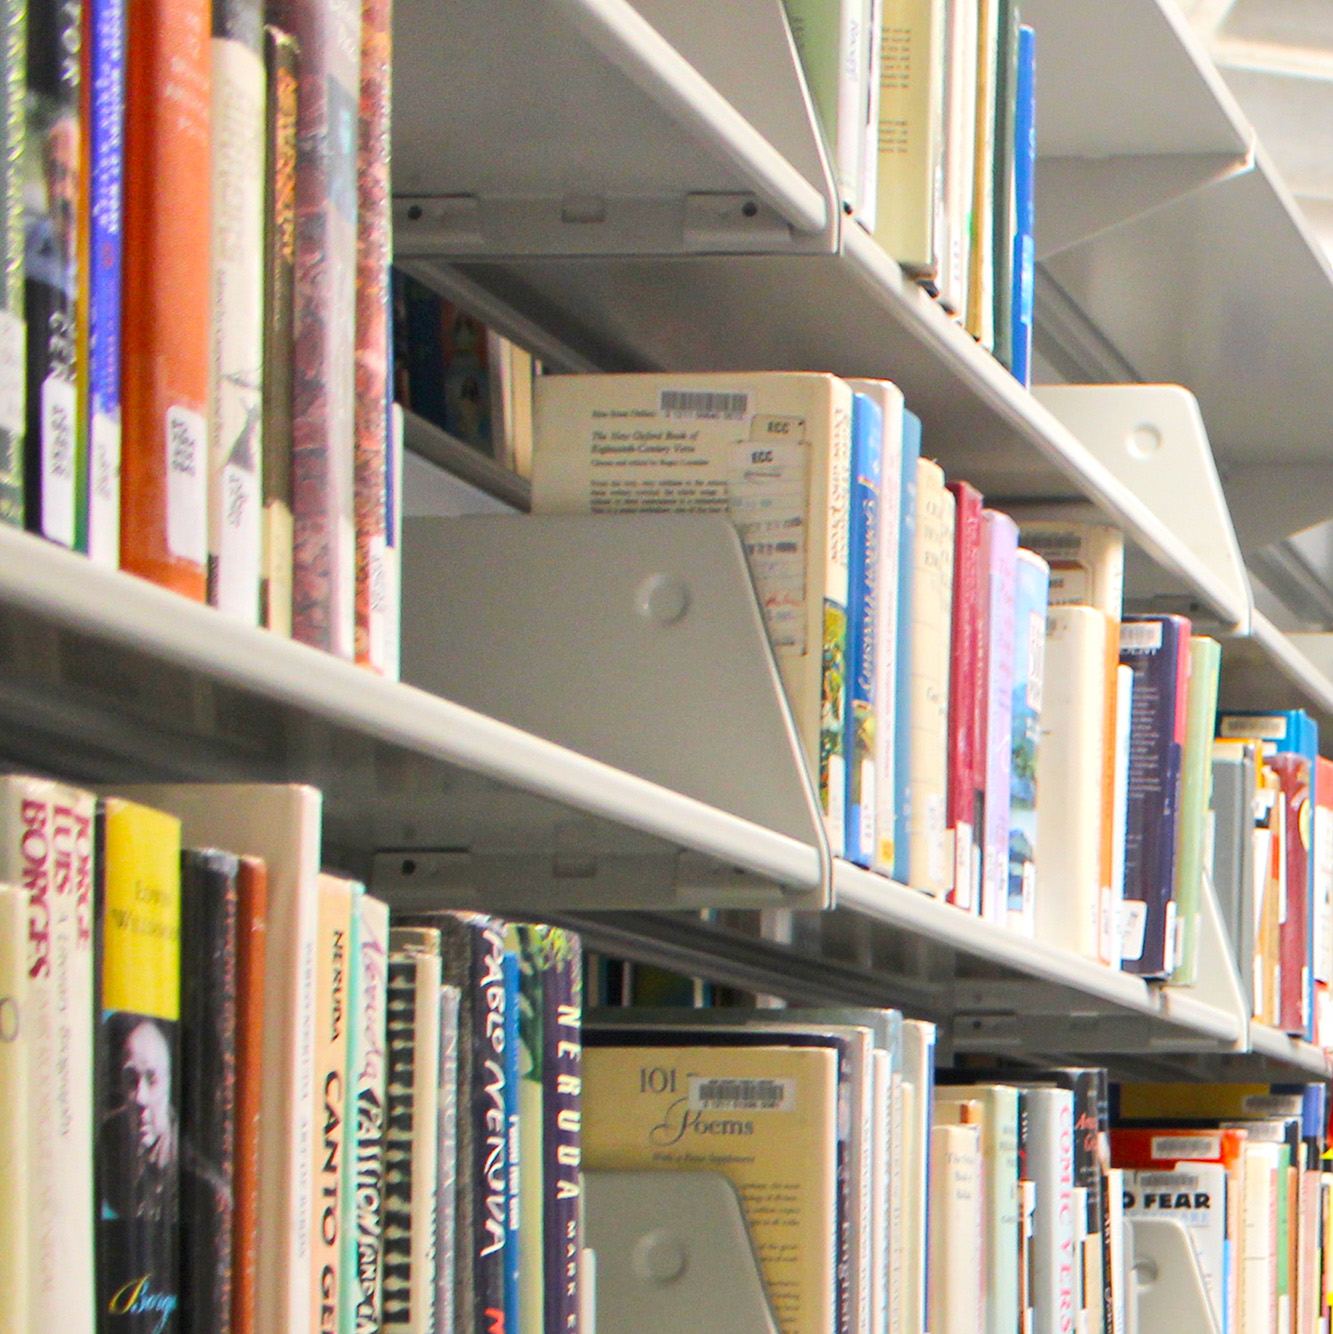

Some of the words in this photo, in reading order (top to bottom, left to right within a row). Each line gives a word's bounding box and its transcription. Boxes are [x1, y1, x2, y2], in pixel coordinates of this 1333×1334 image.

[751, 451, 773, 464] ECC
[767, 421, 789, 434] ECC
[22, 797, 51, 976] BORGES
[55, 803, 76, 896] LUIS
[330, 931, 346, 1043] NERUDA
[481, 924, 506, 1047] PABLO
[557, 1004, 581, 1199] NERUDA
[639, 1066, 679, 1094] 101
[648, 1097, 755, 1147] Poems
[319, 1070, 346, 1246] CANTO
[480, 1060, 507, 1257] NERUDA
[1060, 1103, 1075, 1224] COMIC
[1143, 1193, 1210, 1209] FEAR
[566, 1220, 579, 1297] MARK
